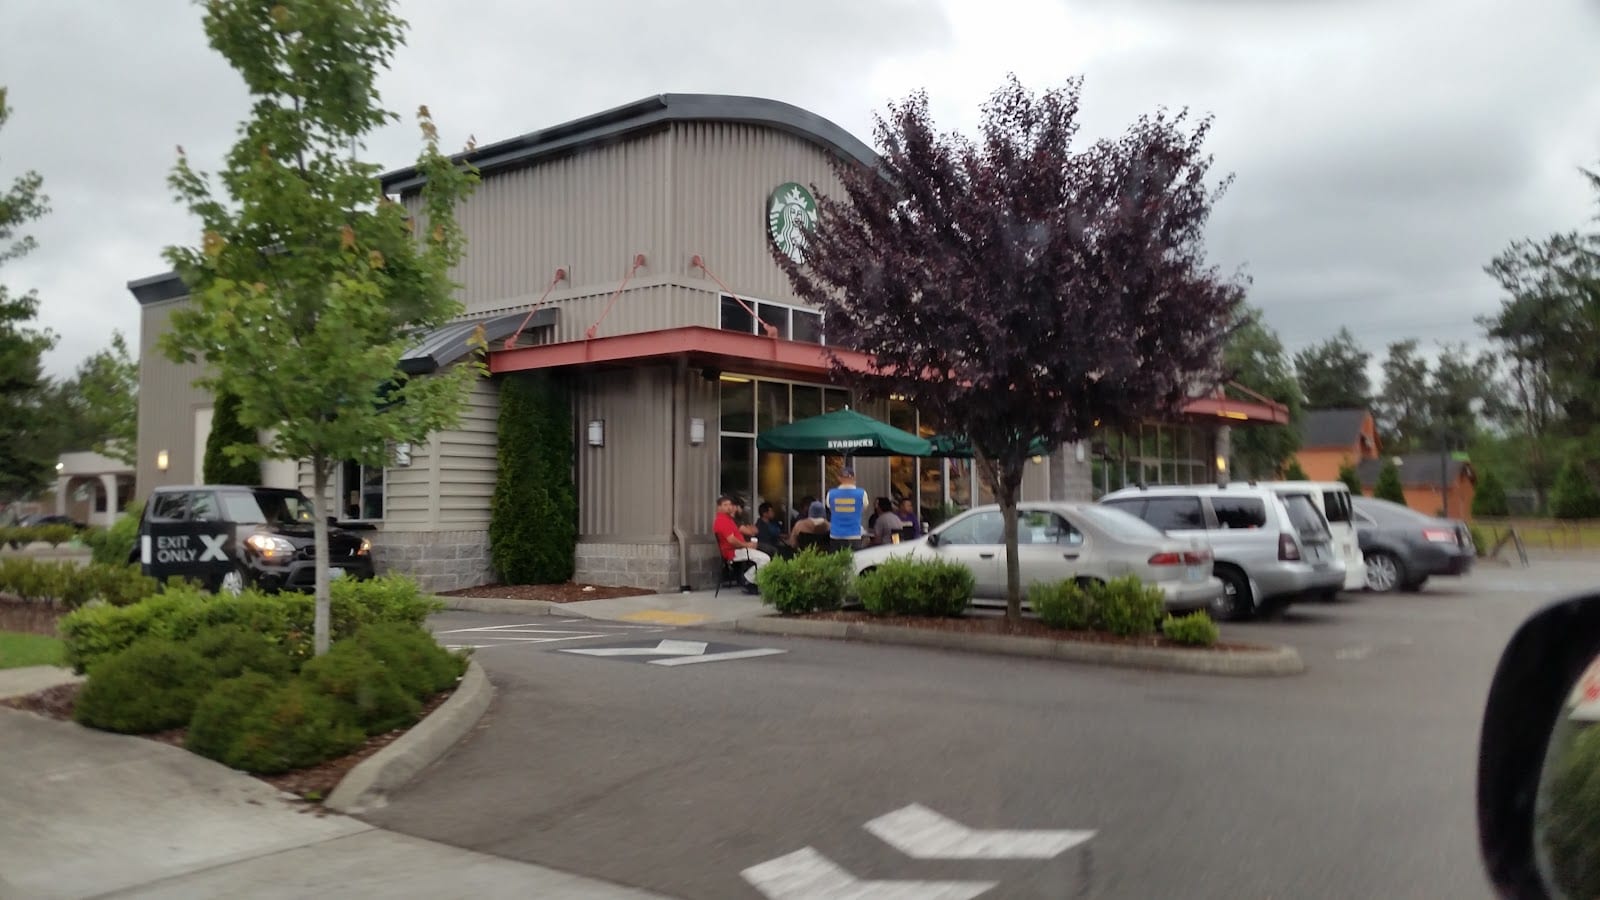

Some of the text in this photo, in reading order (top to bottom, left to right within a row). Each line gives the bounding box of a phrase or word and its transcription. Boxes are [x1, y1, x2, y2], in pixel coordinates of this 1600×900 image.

[828, 439, 873, 448] STARBUCKS
[157, 535, 190, 549] EXIT
[157, 549, 197, 563] ONLY
